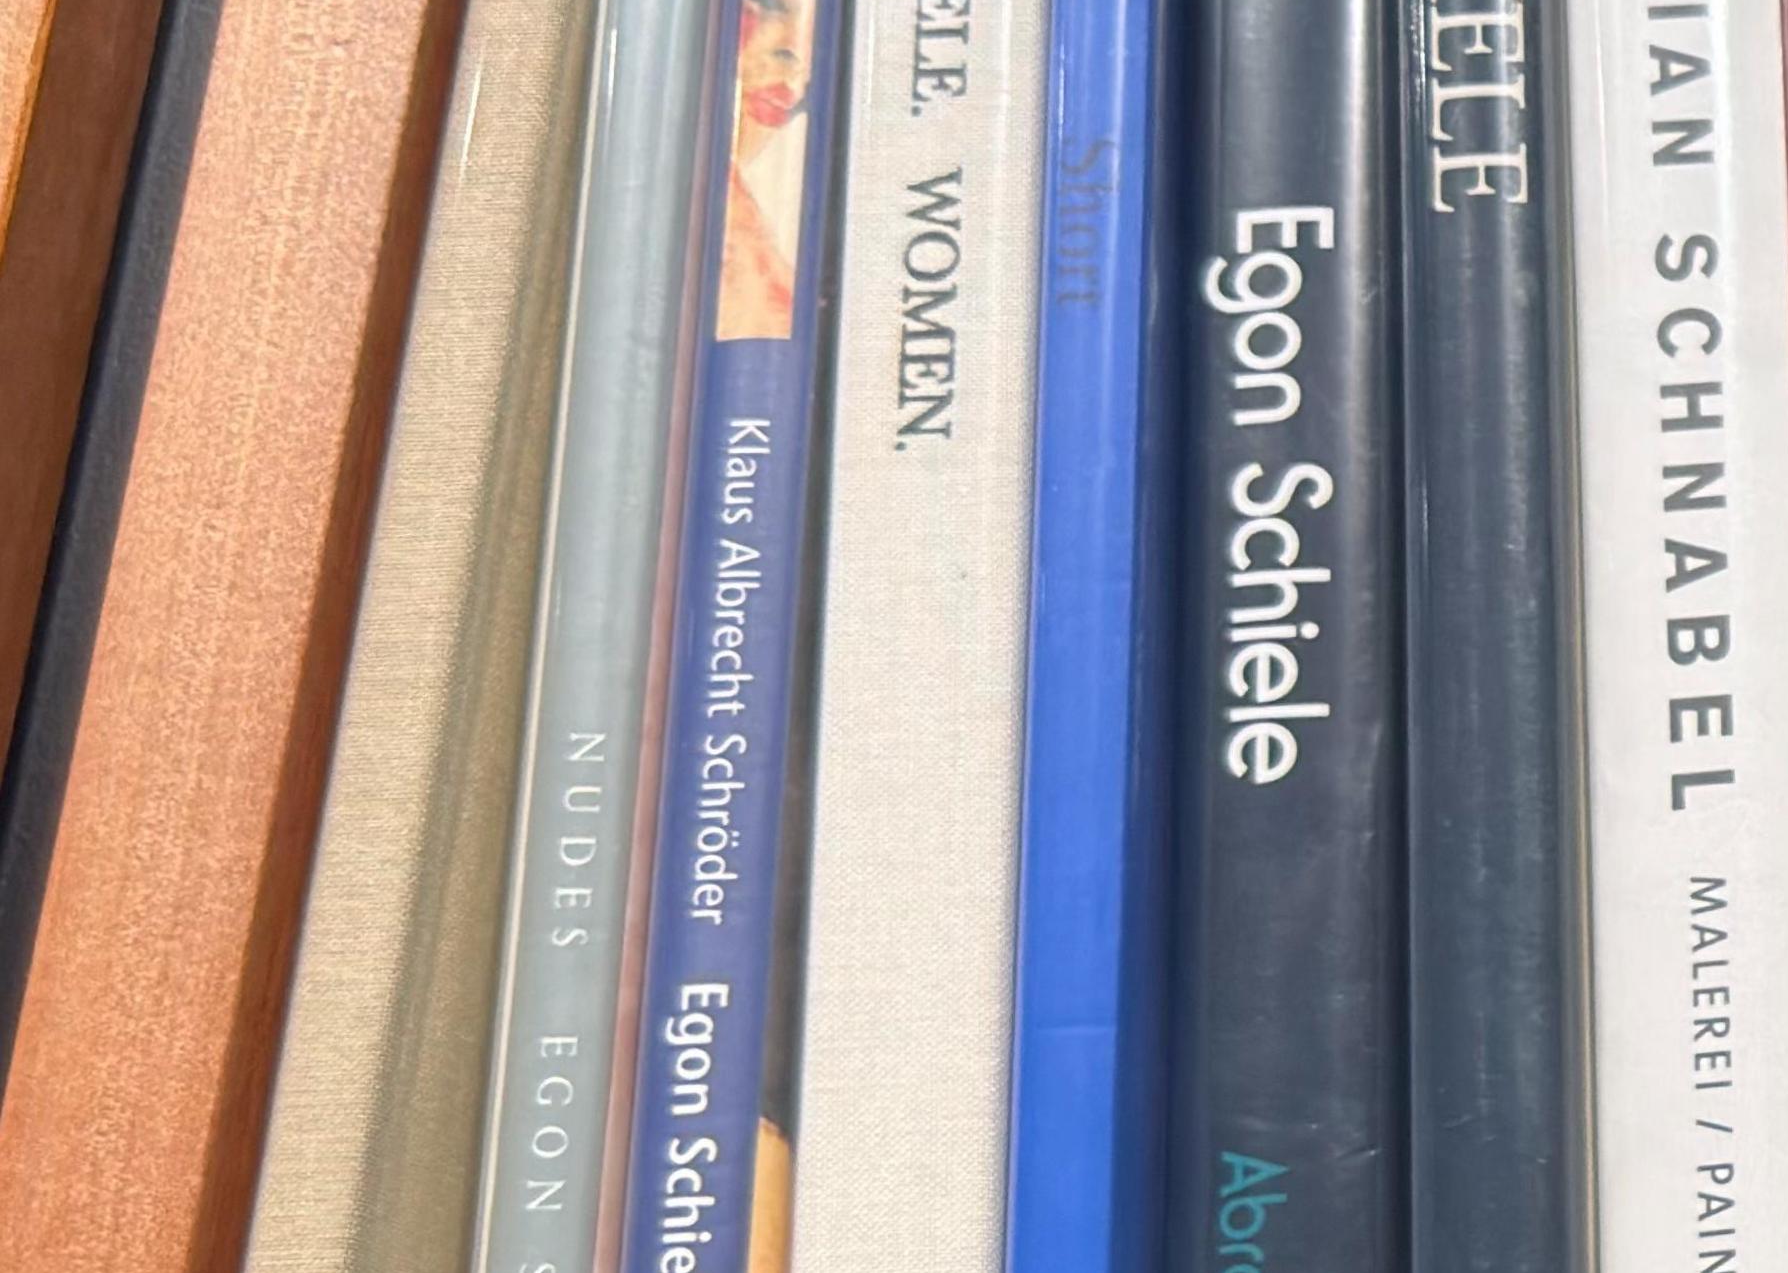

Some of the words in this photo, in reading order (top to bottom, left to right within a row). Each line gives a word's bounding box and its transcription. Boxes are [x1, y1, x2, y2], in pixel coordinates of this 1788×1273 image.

[895, 170, 962, 452] WOMEN.
[1205, 206, 1335, 425] Egon
[721, 419, 772, 524] Klaus
[1654, 233, 1736, 811] SCHNABEL
[706, 540, 761, 715] Albrecht
[1227, 462, 1334, 784] Schiele
[551, 732, 606, 949] NUDES
[691, 735, 747, 924] Schröder
[666, 983, 729, 1114] Egon
[1689, 876, 1733, 1091] MALEREI
[527, 1036, 578, 1211] EGON
